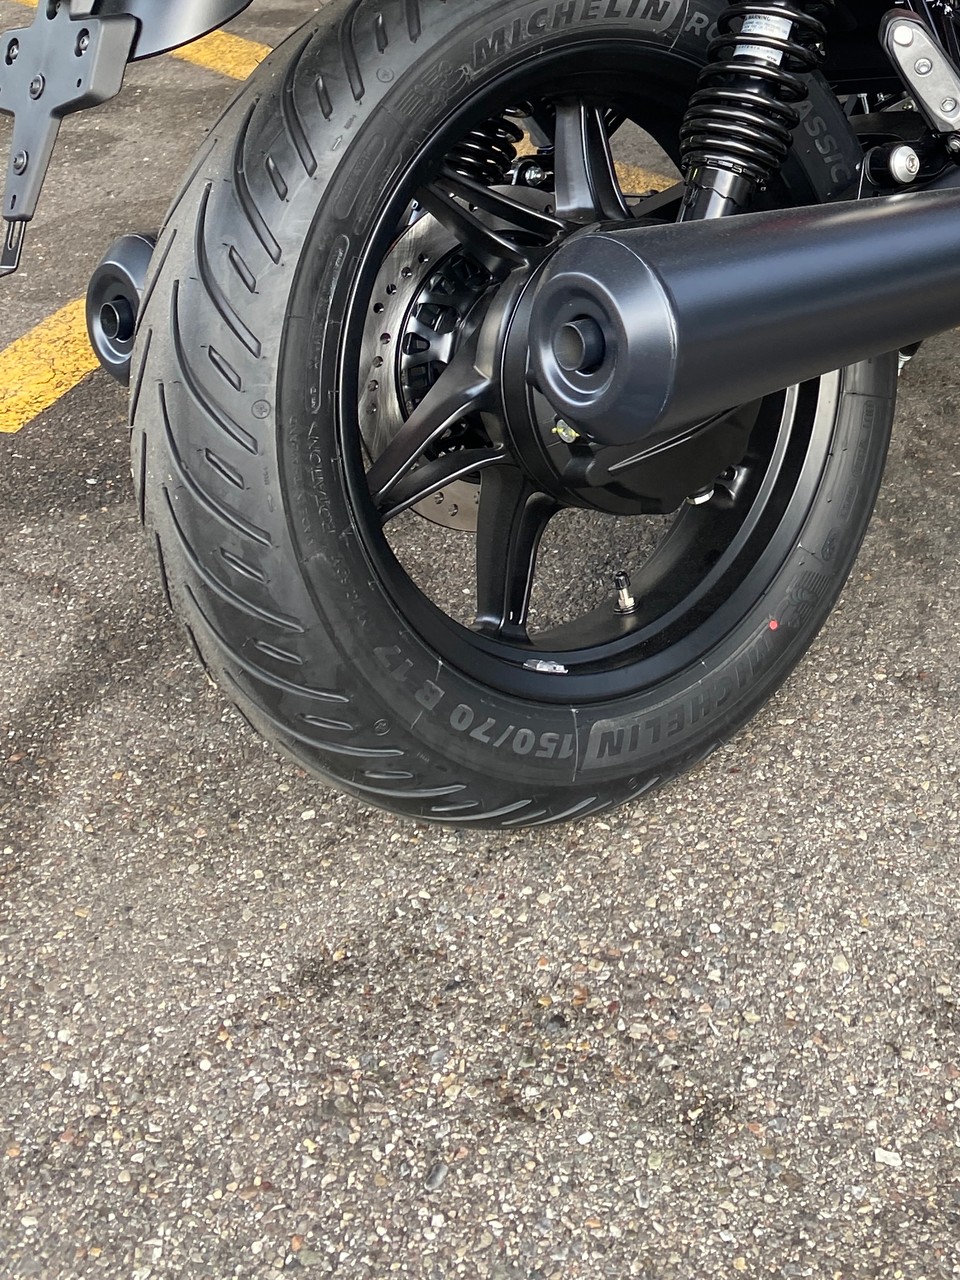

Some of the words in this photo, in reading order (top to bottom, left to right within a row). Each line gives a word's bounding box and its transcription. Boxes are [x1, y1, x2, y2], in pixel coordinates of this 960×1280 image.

[373, 644, 414, 682] 17
[415, 679, 446, 711] R
[597, 630, 771, 759] MICHELIN
[449, 703, 574, 759] 150/70
